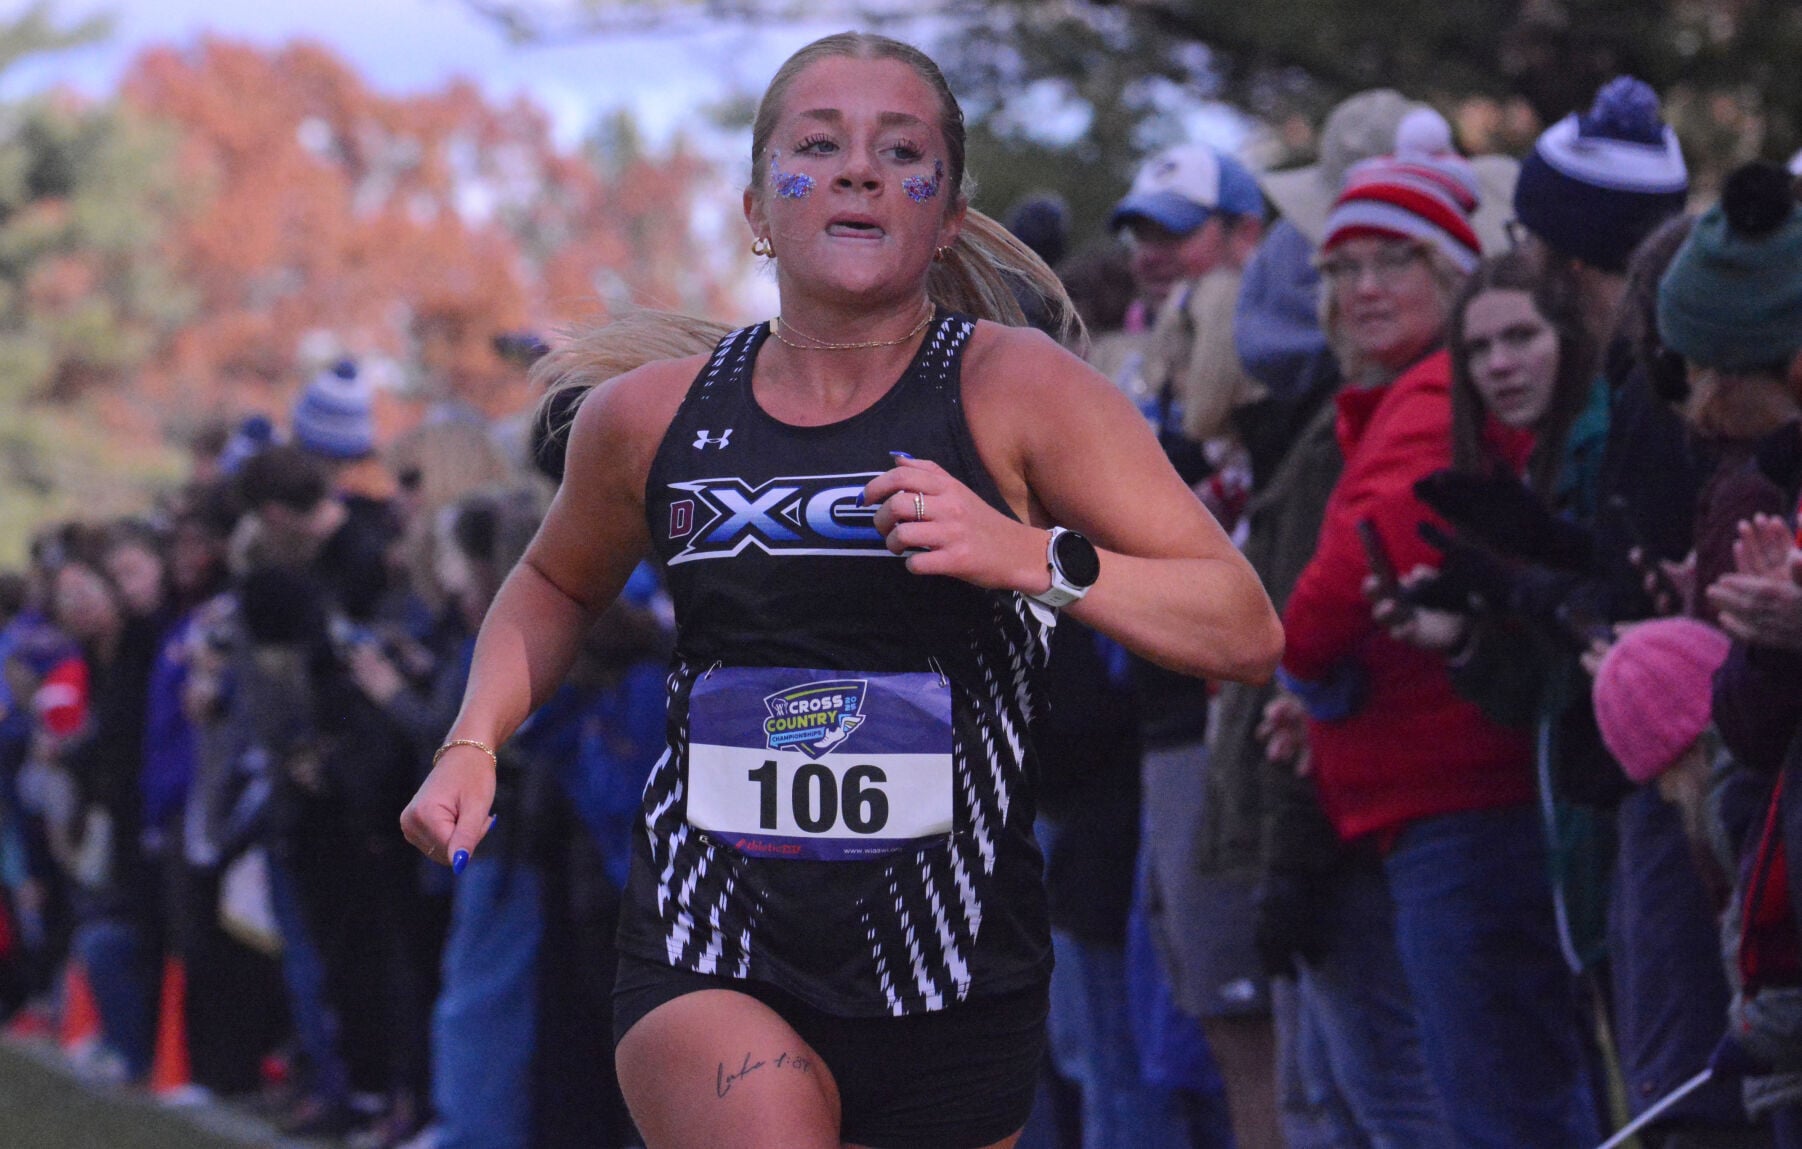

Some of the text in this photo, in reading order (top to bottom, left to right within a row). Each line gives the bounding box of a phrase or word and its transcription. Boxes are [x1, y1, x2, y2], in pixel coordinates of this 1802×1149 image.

[789, 695, 843, 714] CROSS
[767, 710, 838, 732] COUNTRY
[772, 730, 822, 743] CHAMPIONSHIPS
[748, 760, 889, 834] 106
